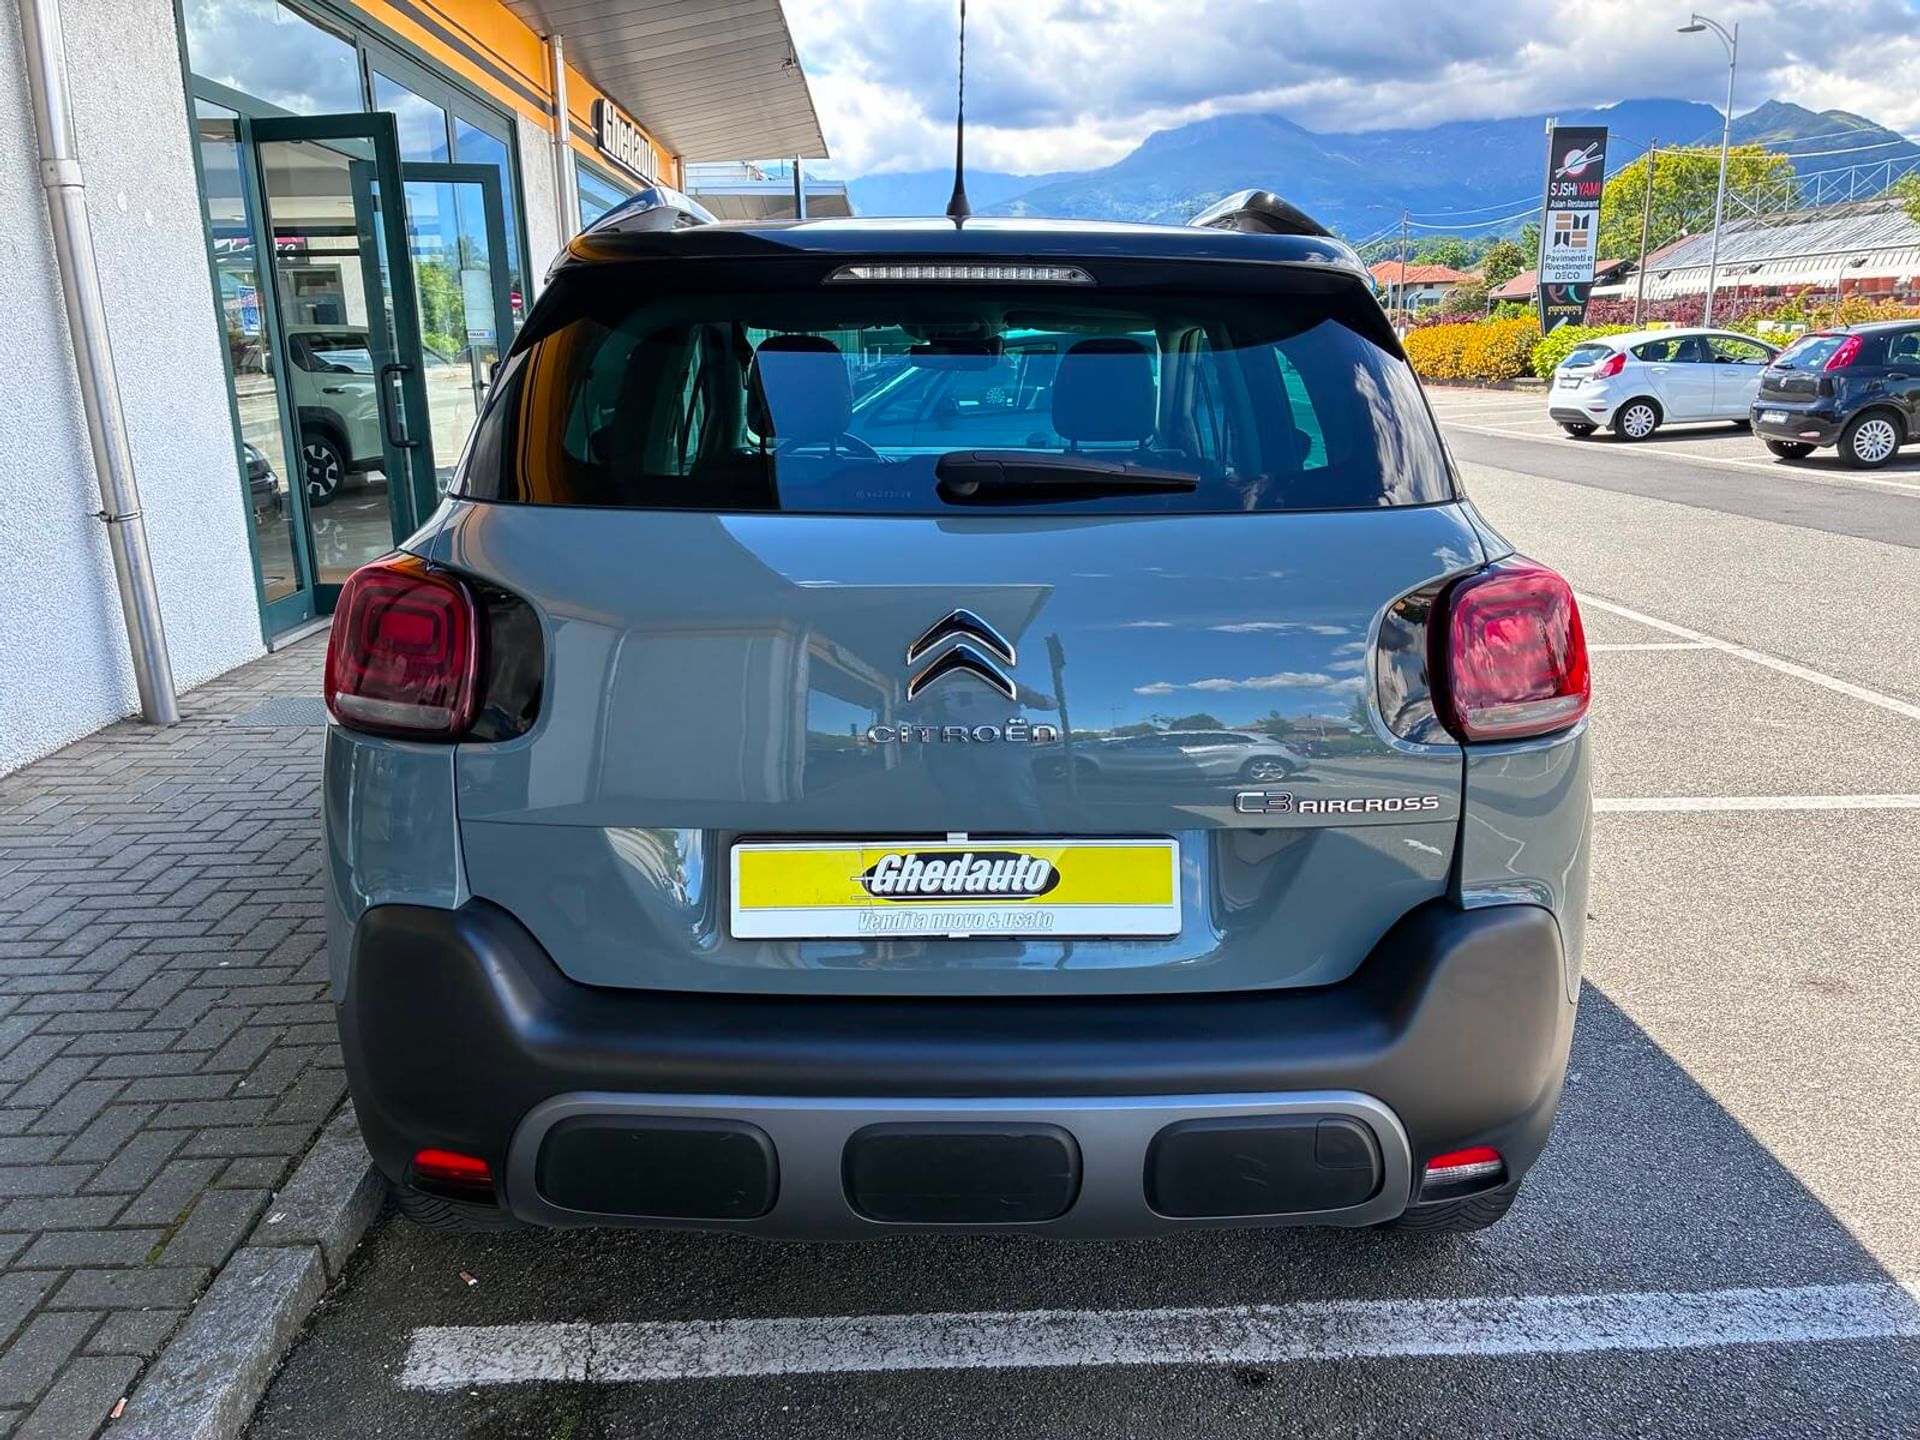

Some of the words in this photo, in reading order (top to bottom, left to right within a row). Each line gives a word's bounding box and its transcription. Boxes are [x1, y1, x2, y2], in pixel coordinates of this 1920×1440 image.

[602, 98, 658, 184] Ghedauto
[1550, 200, 1566, 208] Asian
[1567, 199, 1599, 208] Restaurant
[1545, 263, 1592, 271] Rivestimenti
[1546, 254, 1586, 262] Pavimenti
[867, 717, 1058, 743] CITROËN
[1236, 791, 1293, 814] C3
[1298, 796, 1440, 813] AIRCROSS
[870, 853, 1051, 894] Ghedauto
[859, 910, 928, 930] Vendita
[930, 911, 985, 930] nuovo
[986, 911, 1002, 930] &
[1003, 911, 1055, 930] usato
